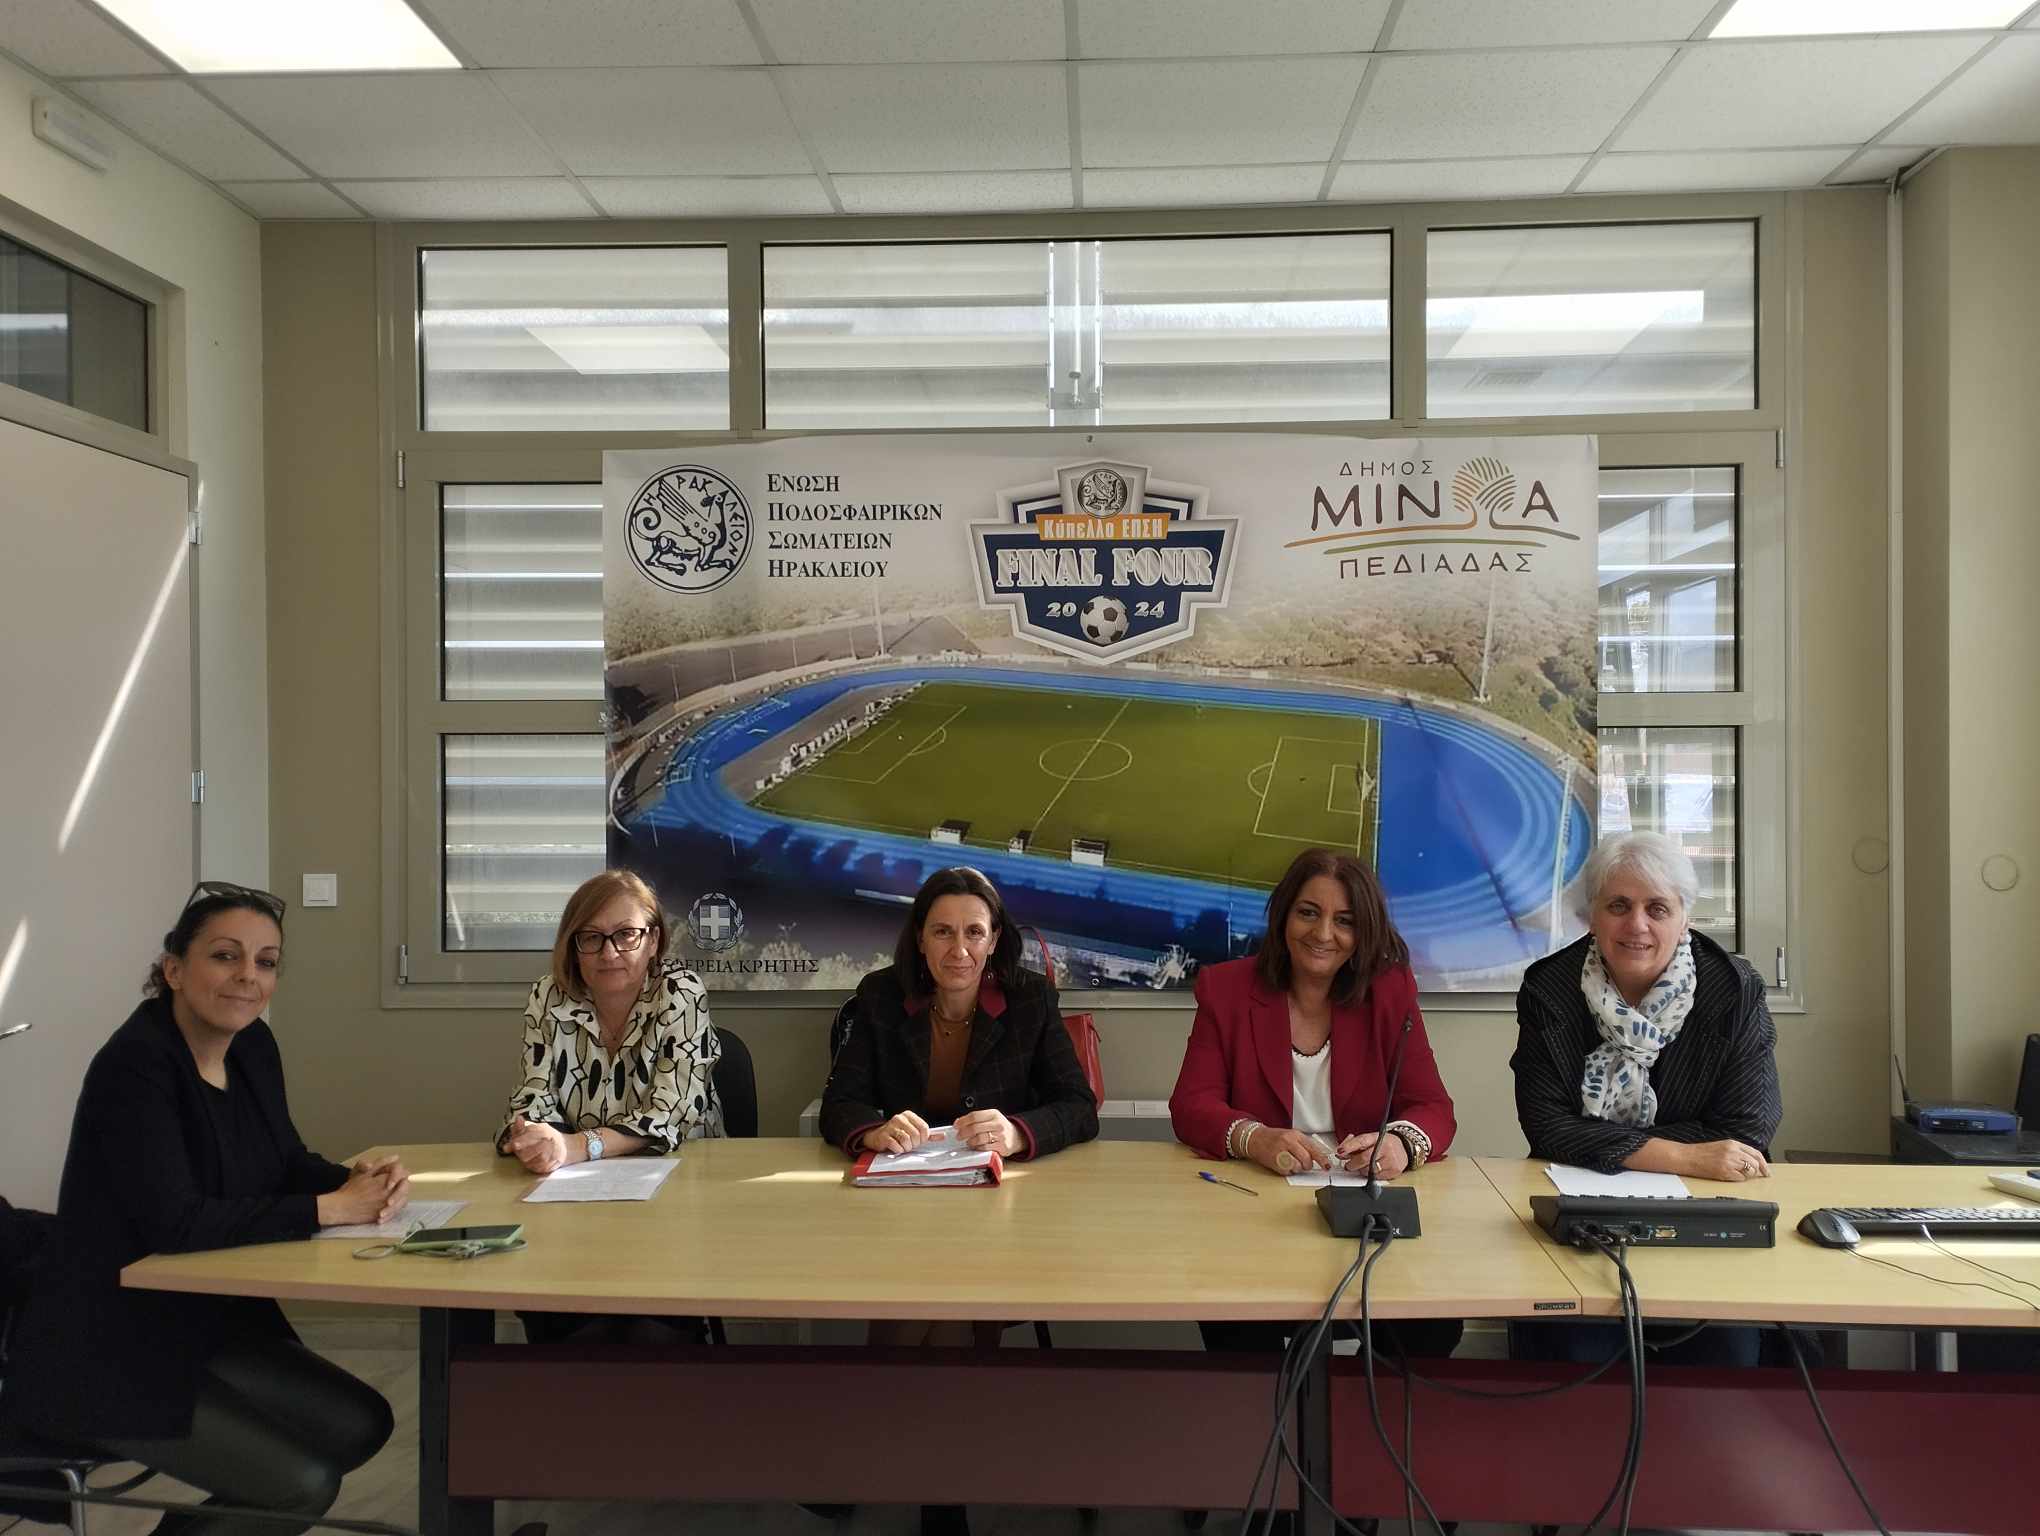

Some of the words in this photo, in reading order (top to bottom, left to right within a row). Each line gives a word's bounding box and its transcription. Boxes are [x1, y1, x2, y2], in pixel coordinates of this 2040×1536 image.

[1339, 460, 1433, 476] ΔΗΜΟΣ
[767, 473, 840, 492] ΕΝΩΣΗ
[767, 502, 943, 522] ΠΟΔΟΣΦΑΙΡΙΚΩΝ
[1043, 518, 1115, 539] Κύπελλο
[1122, 518, 1163, 538] ΕΠΣΗ
[767, 530, 893, 550] ΣΩΜΑΤΕΙΩΝ
[767, 559, 889, 578] ΗΡΑΚΛΕΙΟΥ
[995, 547, 1103, 587] FINAL
[1111, 547, 1214, 586] FOUR
[1340, 551, 1533, 579] ΠΕΔΙΑΔΑΣ
[1046, 601, 1077, 618] 20
[1134, 601, 1165, 618] 24
[735, 959, 819, 973] ΚΡΗΤΗΣ
